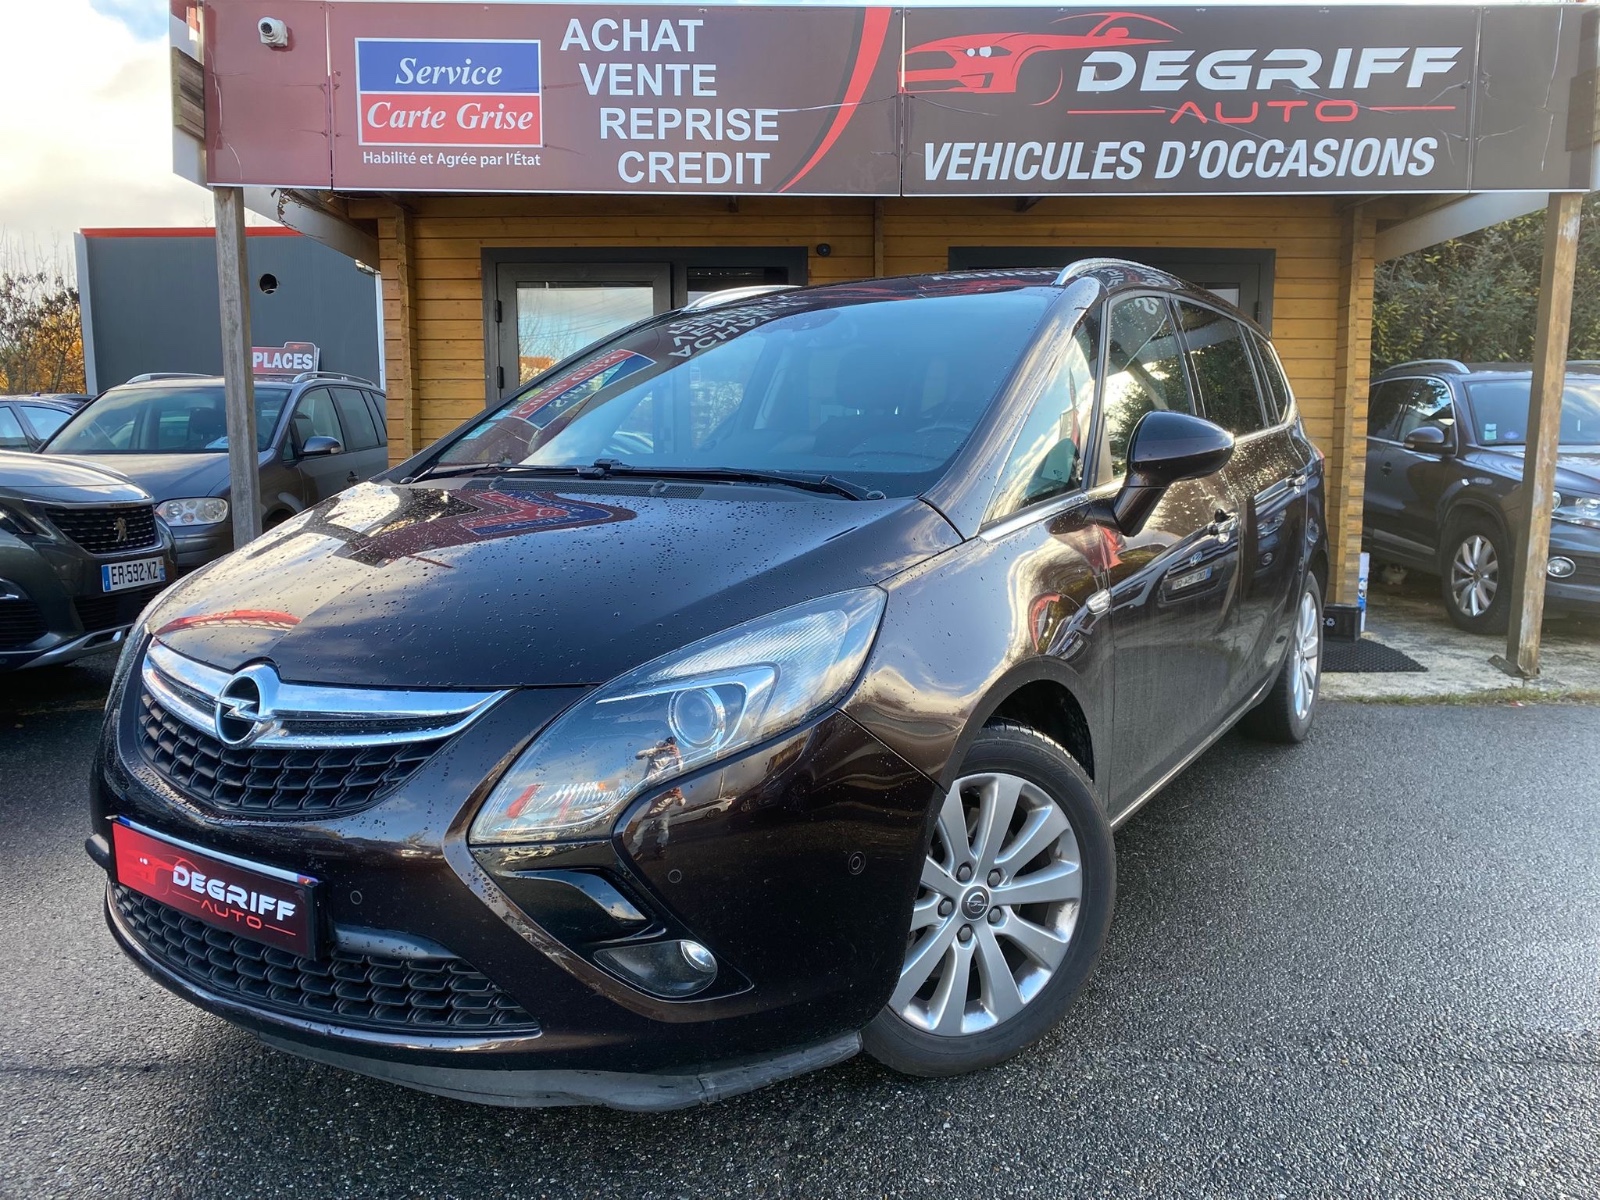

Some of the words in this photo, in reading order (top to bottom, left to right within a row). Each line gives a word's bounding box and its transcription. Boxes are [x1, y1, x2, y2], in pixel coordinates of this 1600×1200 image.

[559, 18, 704, 52] ACHAT
[395, 57, 503, 86] Service
[578, 62, 717, 97] VENTE
[1076, 46, 1463, 92] DEGRIFF
[367, 101, 447, 129] Carte
[456, 102, 534, 130] Grise
[600, 107, 779, 141] REPRISE
[1169, 99, 1359, 125] AUTO
[363, 152, 416, 165] Habilité
[419, 154, 433, 165] et
[436, 152, 477, 168] Agrée
[480, 155, 502, 168] par
[505, 151, 541, 166] l'État
[617, 150, 771, 185] CREDIT
[924, 140, 1146, 181] VEHICULES
[1154, 136, 1438, 180] D'OCCASIONS
[252, 352, 314, 370] PLACES
[111, 561, 158, 585] ER-592-XZ
[172, 865, 296, 921] DEGRIFF
[201, 900, 262, 930] AUTO
